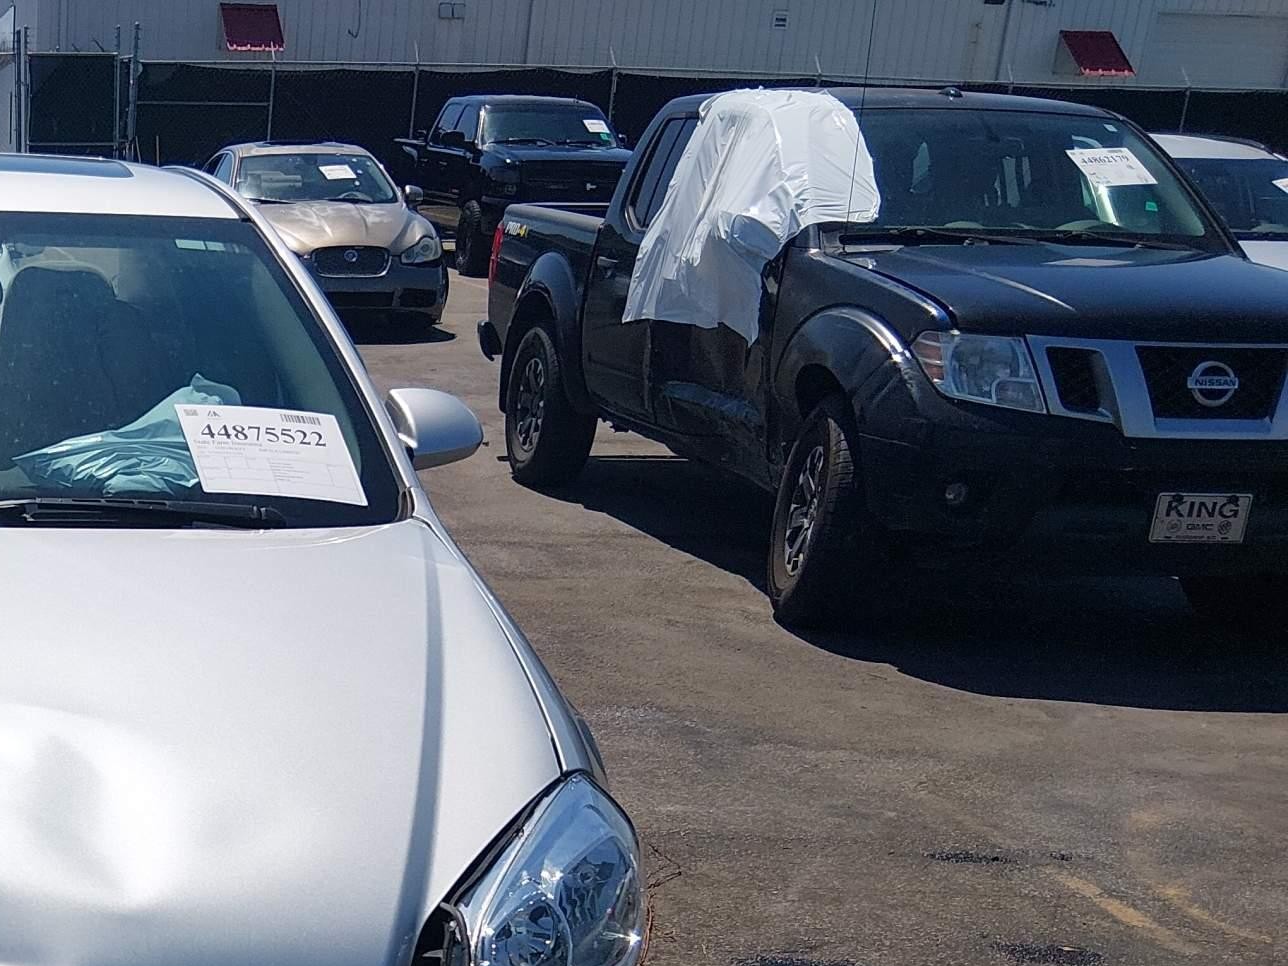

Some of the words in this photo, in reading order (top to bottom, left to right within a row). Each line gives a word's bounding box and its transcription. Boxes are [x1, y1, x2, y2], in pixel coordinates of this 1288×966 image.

[1194, 379, 1235, 387] NISSAN
[201, 423, 327, 447] 44875522
[1165, 500, 1239, 518] KING
